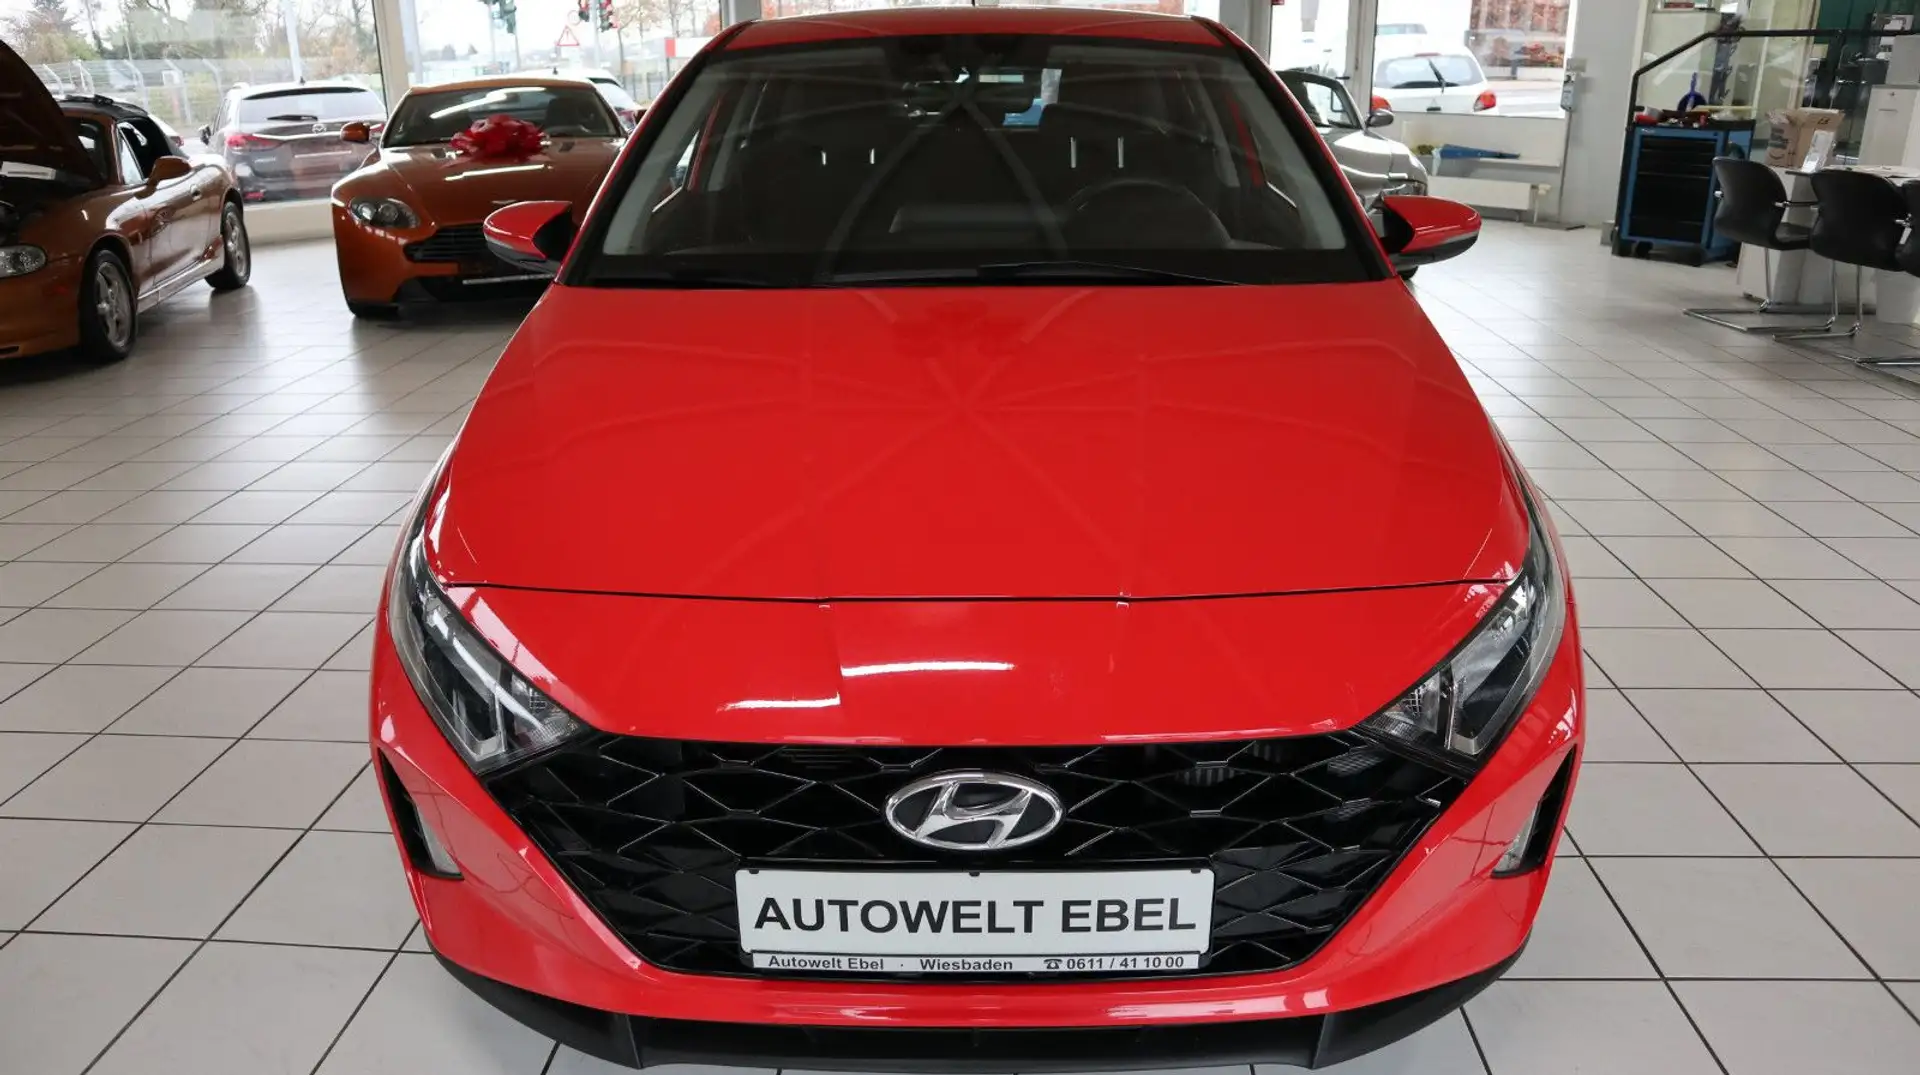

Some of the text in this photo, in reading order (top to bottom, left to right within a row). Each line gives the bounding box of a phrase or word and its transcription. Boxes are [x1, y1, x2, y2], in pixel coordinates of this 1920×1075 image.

[754, 897, 1196, 934] AUTOWELT EBEL
[768, 955, 842, 970] Autowelt
[847, 957, 884, 970] Ebel
[919, 958, 1013, 971] Wiesbaden
[1066, 958, 1103, 970] 0611
